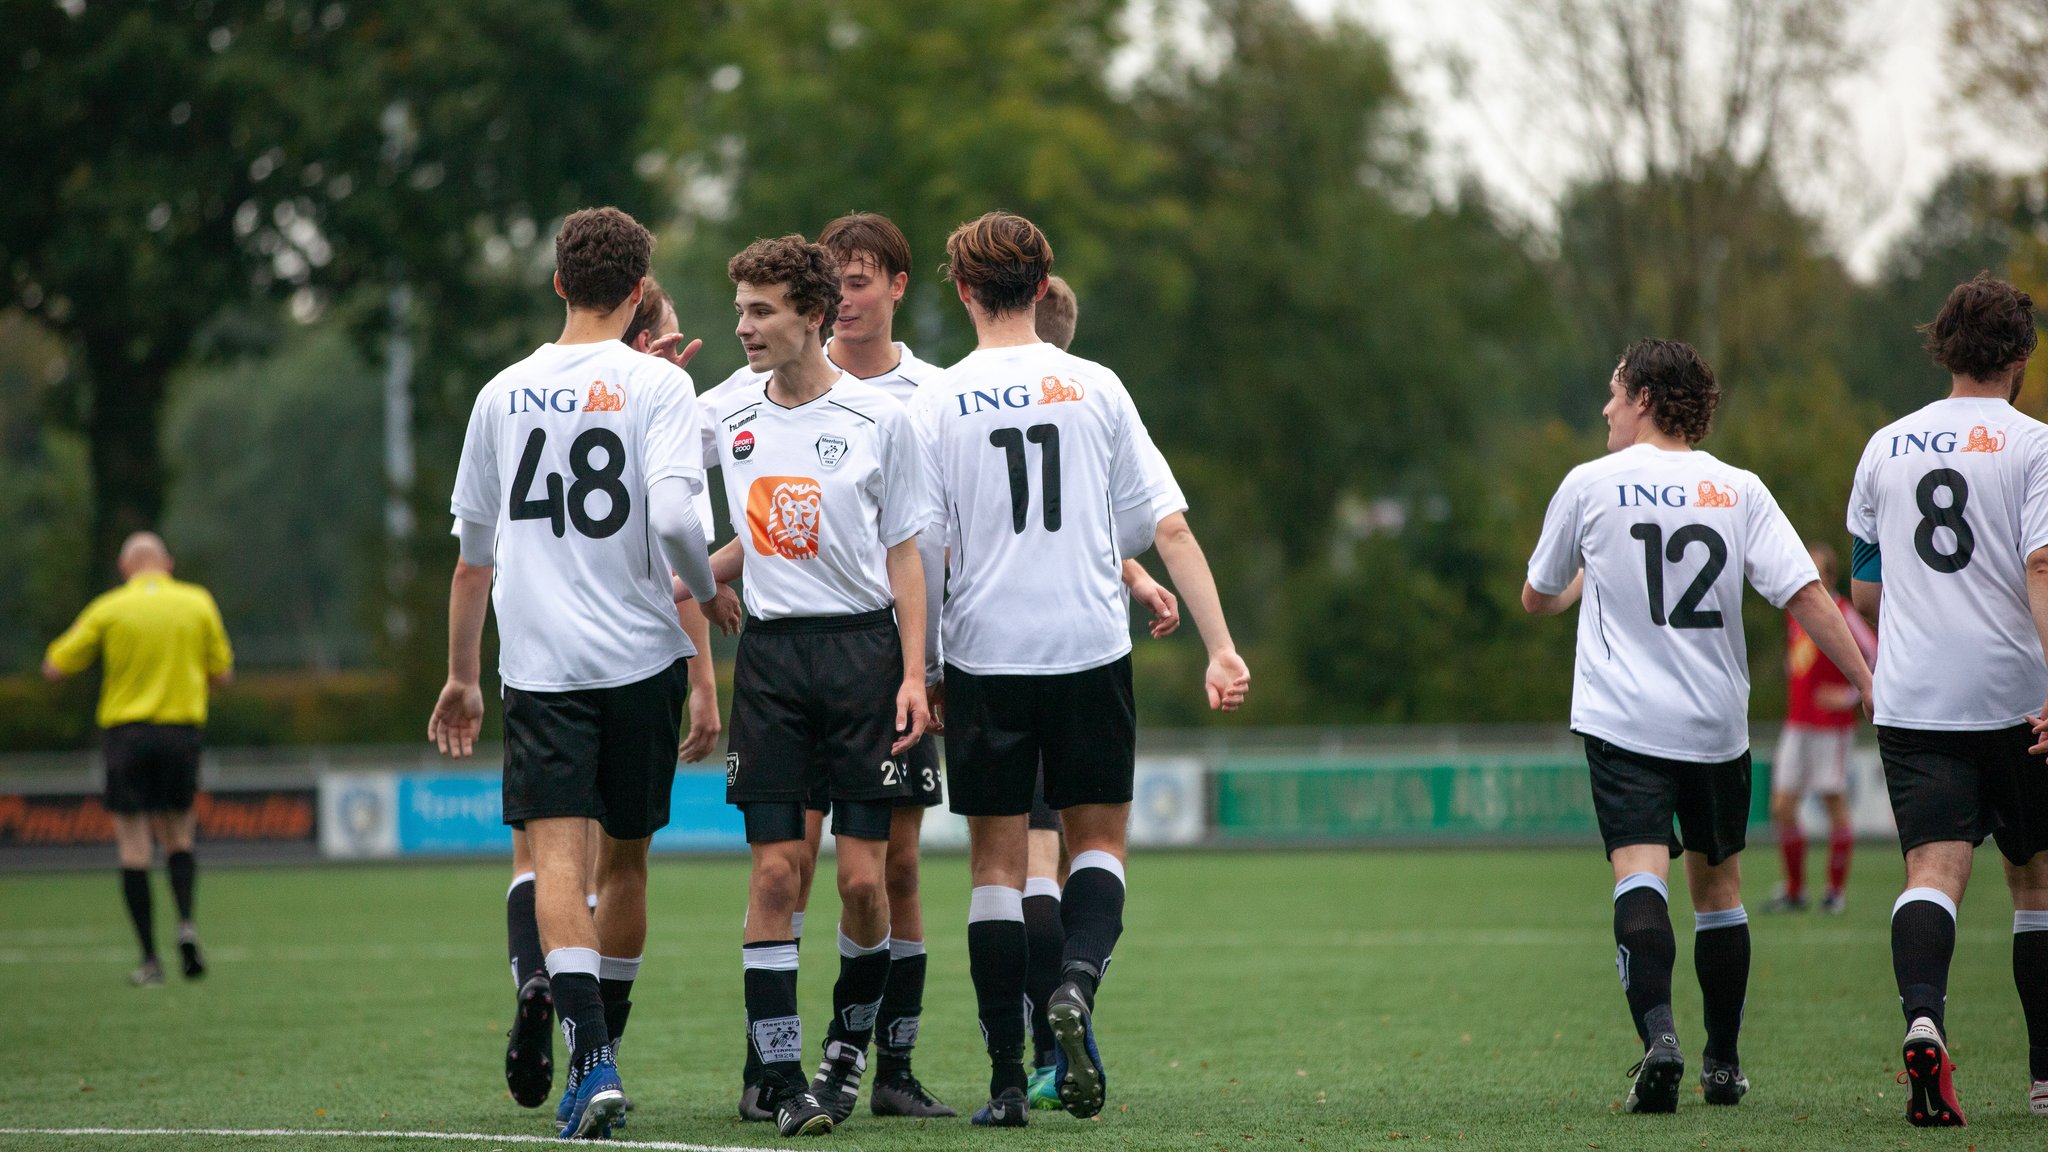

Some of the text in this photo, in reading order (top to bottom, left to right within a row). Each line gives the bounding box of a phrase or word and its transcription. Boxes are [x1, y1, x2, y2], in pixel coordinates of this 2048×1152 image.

[509, 388, 578, 415] ING
[955, 385, 1031, 416] ING
[729, 410, 757, 432] hummel
[733, 438, 753, 447] SPORT
[735, 444, 751, 453] 2000
[1889, 431, 1958, 458] ING
[510, 428, 631, 539] 48
[989, 423, 1062, 535] 11
[1616, 484, 1687, 508] ING
[1914, 468, 1975, 573] 8
[1630, 523, 1727, 629] 12
[922, 768, 935, 791] 3
[762, 1020, 800, 1029] Meerburg
